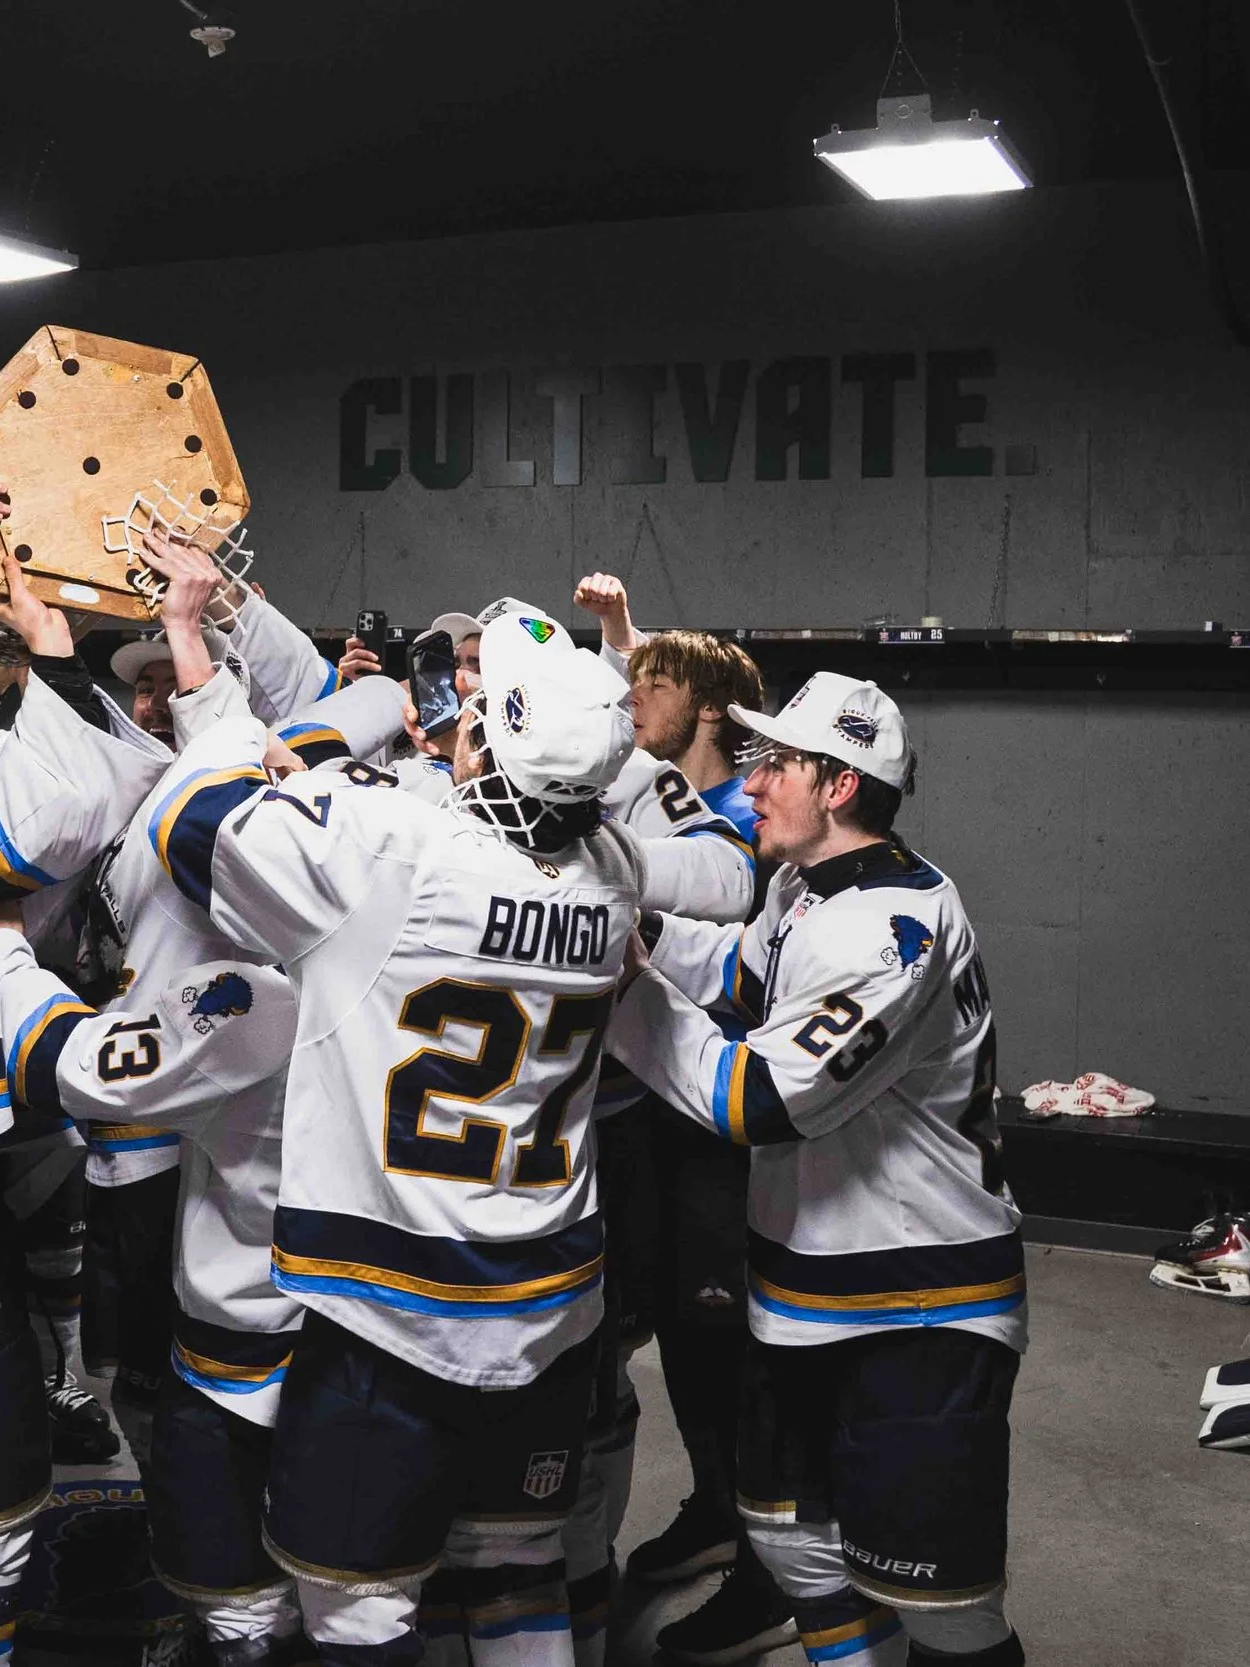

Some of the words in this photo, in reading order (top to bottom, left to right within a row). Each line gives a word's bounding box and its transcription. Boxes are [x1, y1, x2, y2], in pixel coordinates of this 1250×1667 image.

[340, 349, 1037, 492] CULTIVATE.
[478, 895, 610, 965] BONGO
[98, 1013, 162, 1085] 13
[383, 976, 617, 1188] 27
[791, 992, 888, 1083] 23
